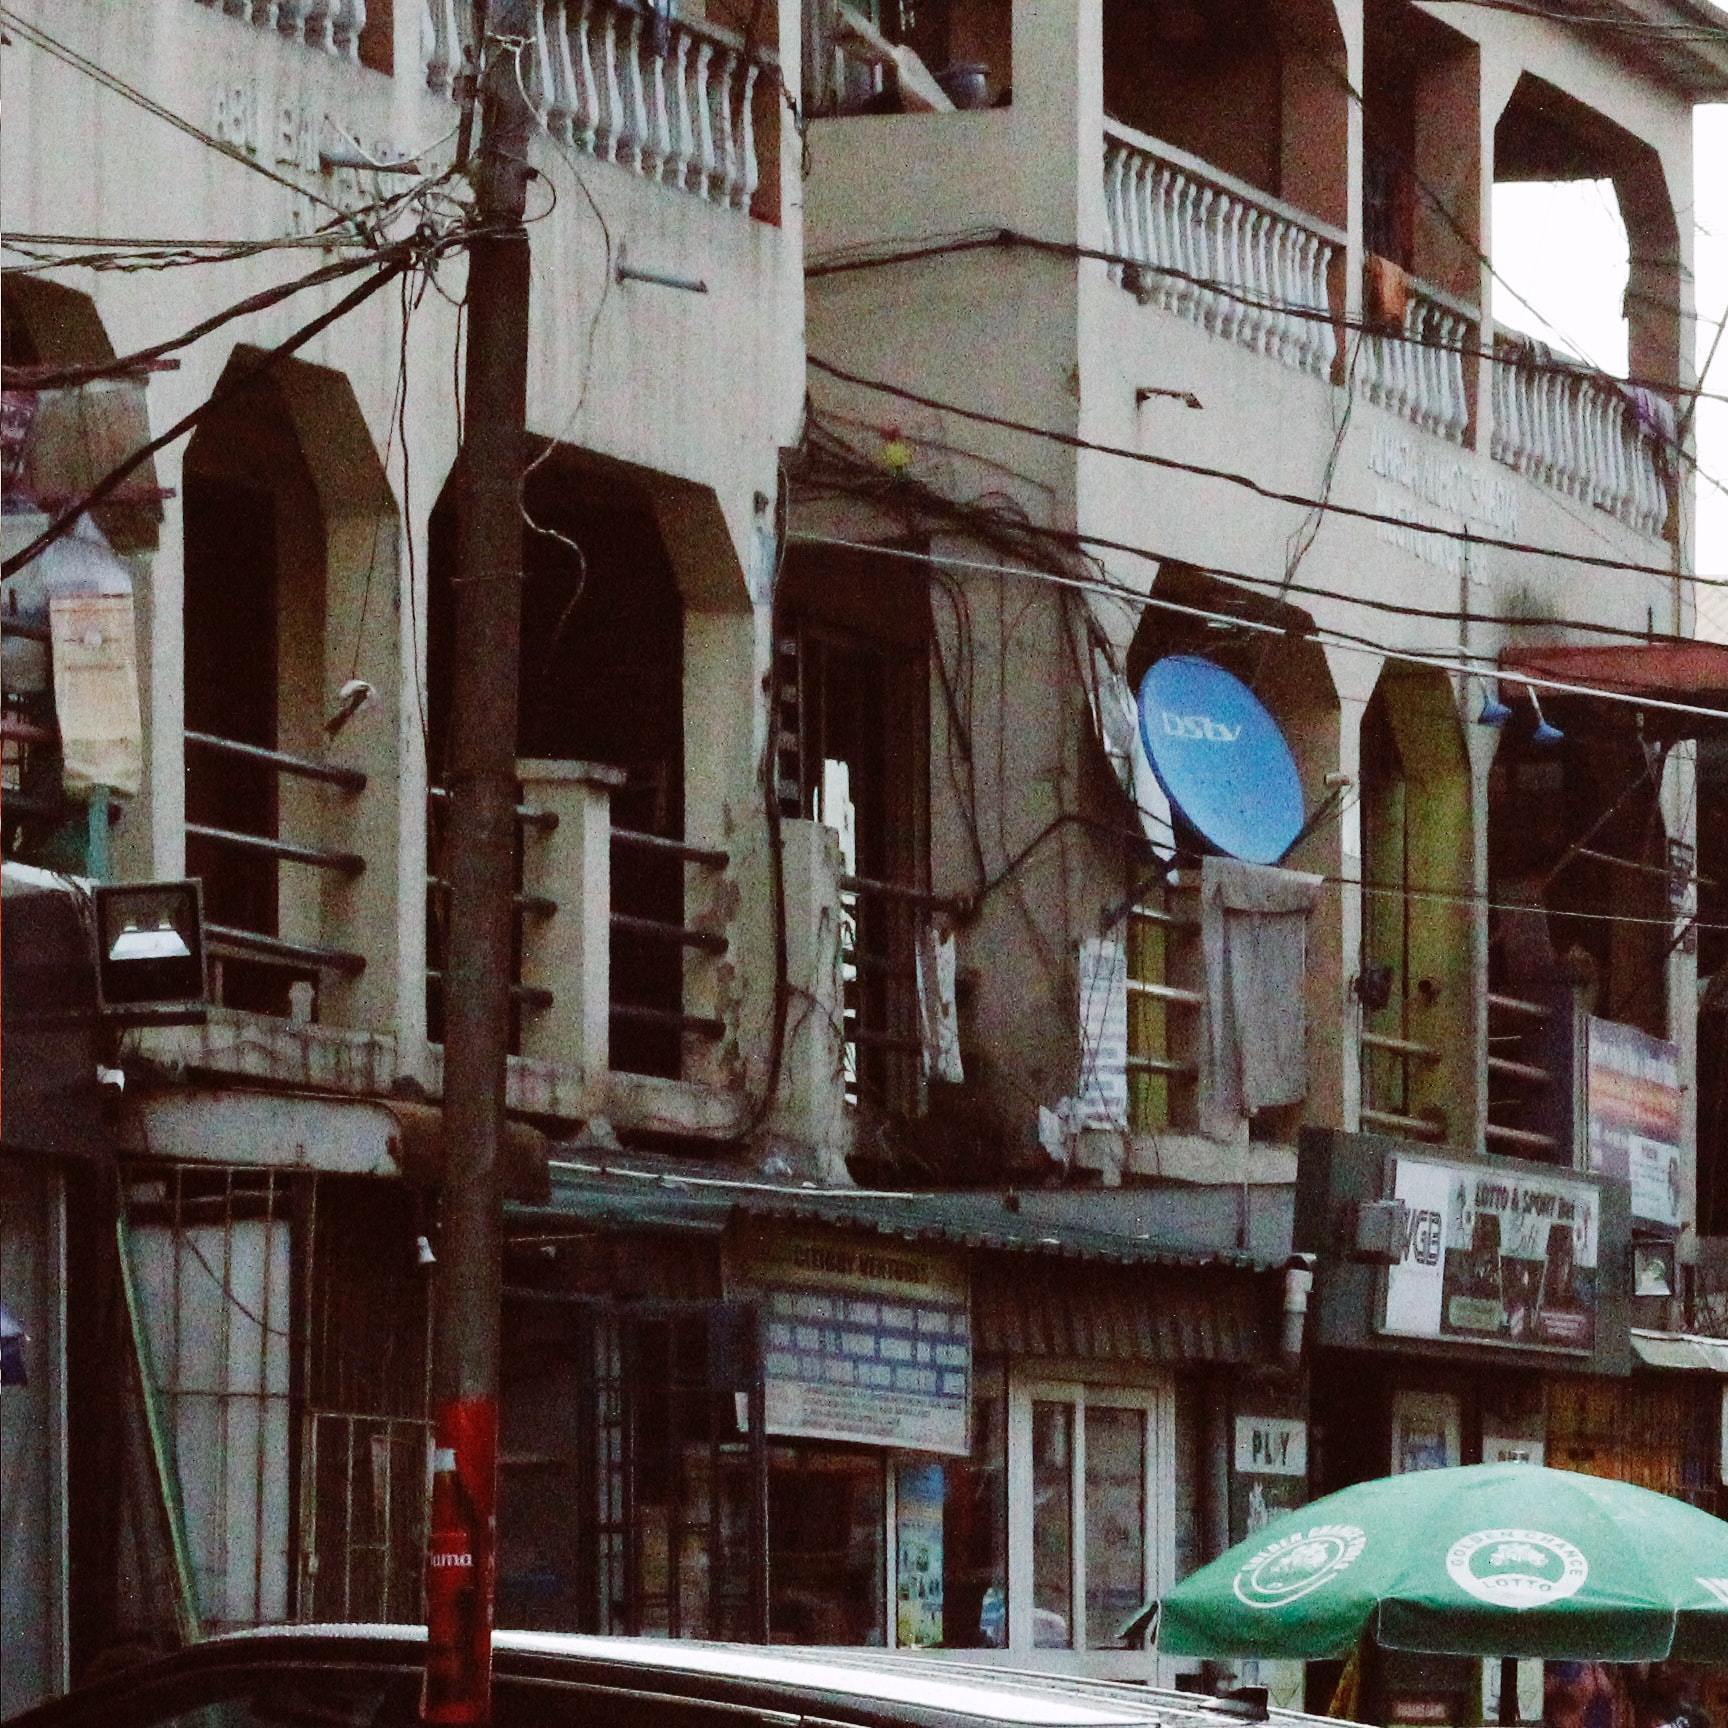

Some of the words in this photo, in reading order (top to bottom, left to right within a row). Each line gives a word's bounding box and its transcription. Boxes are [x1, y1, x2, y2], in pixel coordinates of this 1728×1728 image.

[1450, 1530, 1514, 1567] GOLDEN
[1524, 1530, 1583, 1577] CHANCE
[1481, 1578, 1552, 1592] LOTTO
